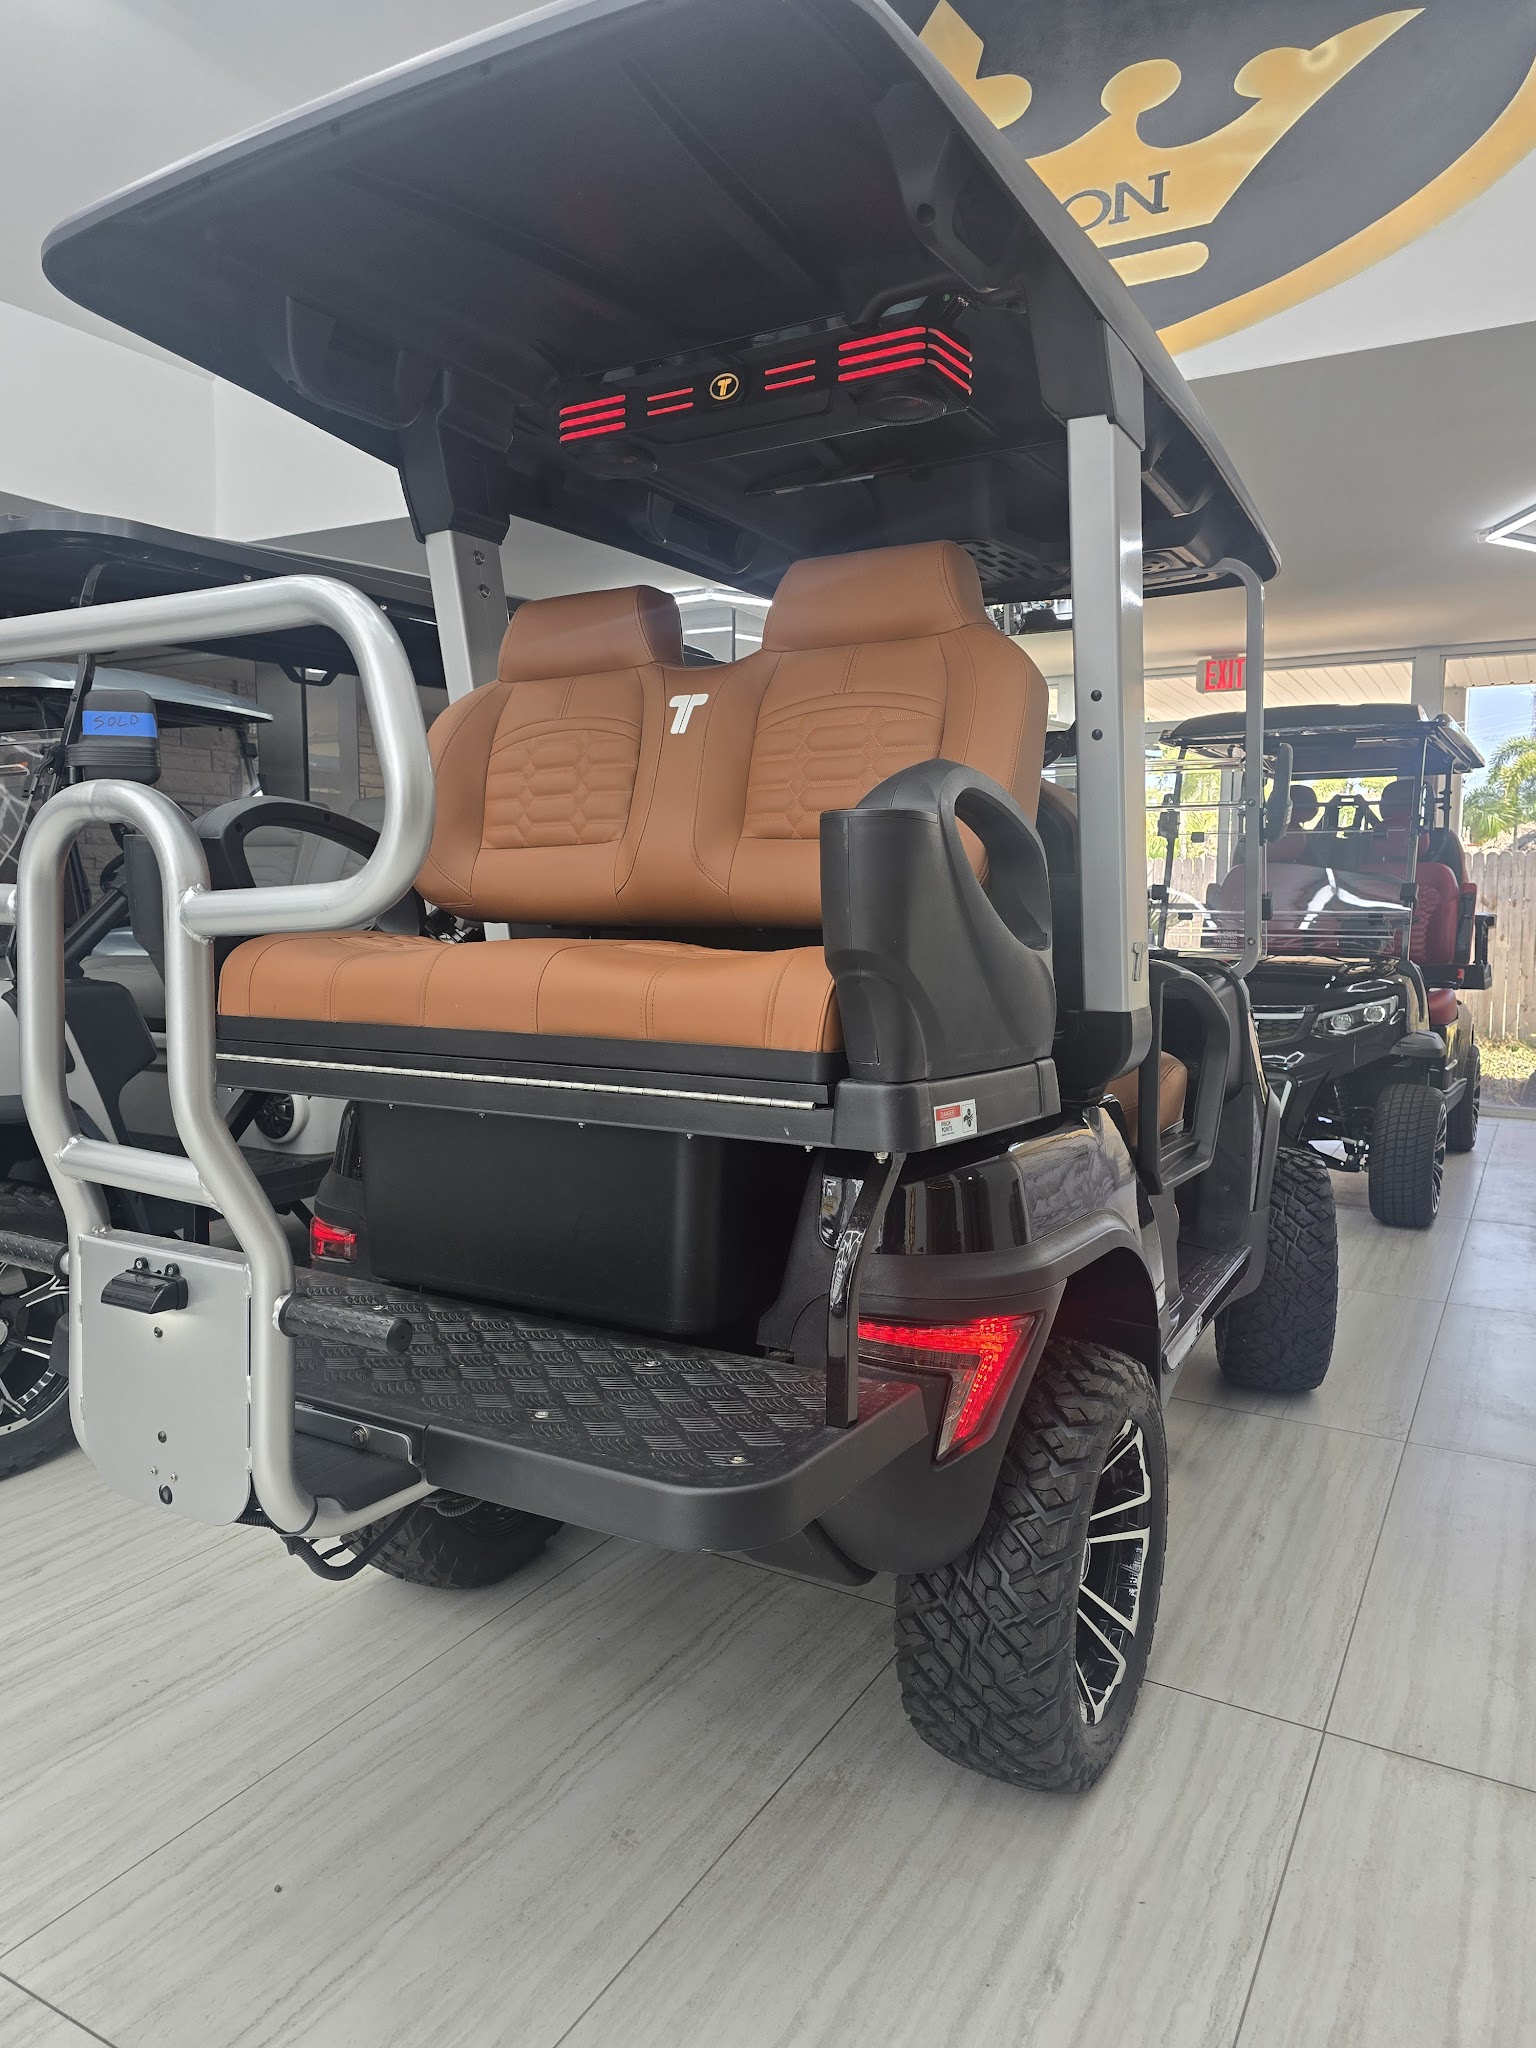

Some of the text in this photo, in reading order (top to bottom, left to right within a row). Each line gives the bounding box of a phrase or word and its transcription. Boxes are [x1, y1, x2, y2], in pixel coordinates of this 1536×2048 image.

[1205, 658, 1246, 691] EXIT
[93, 714, 140, 730] SOLD
[940, 1109, 956, 1118] DANGER
